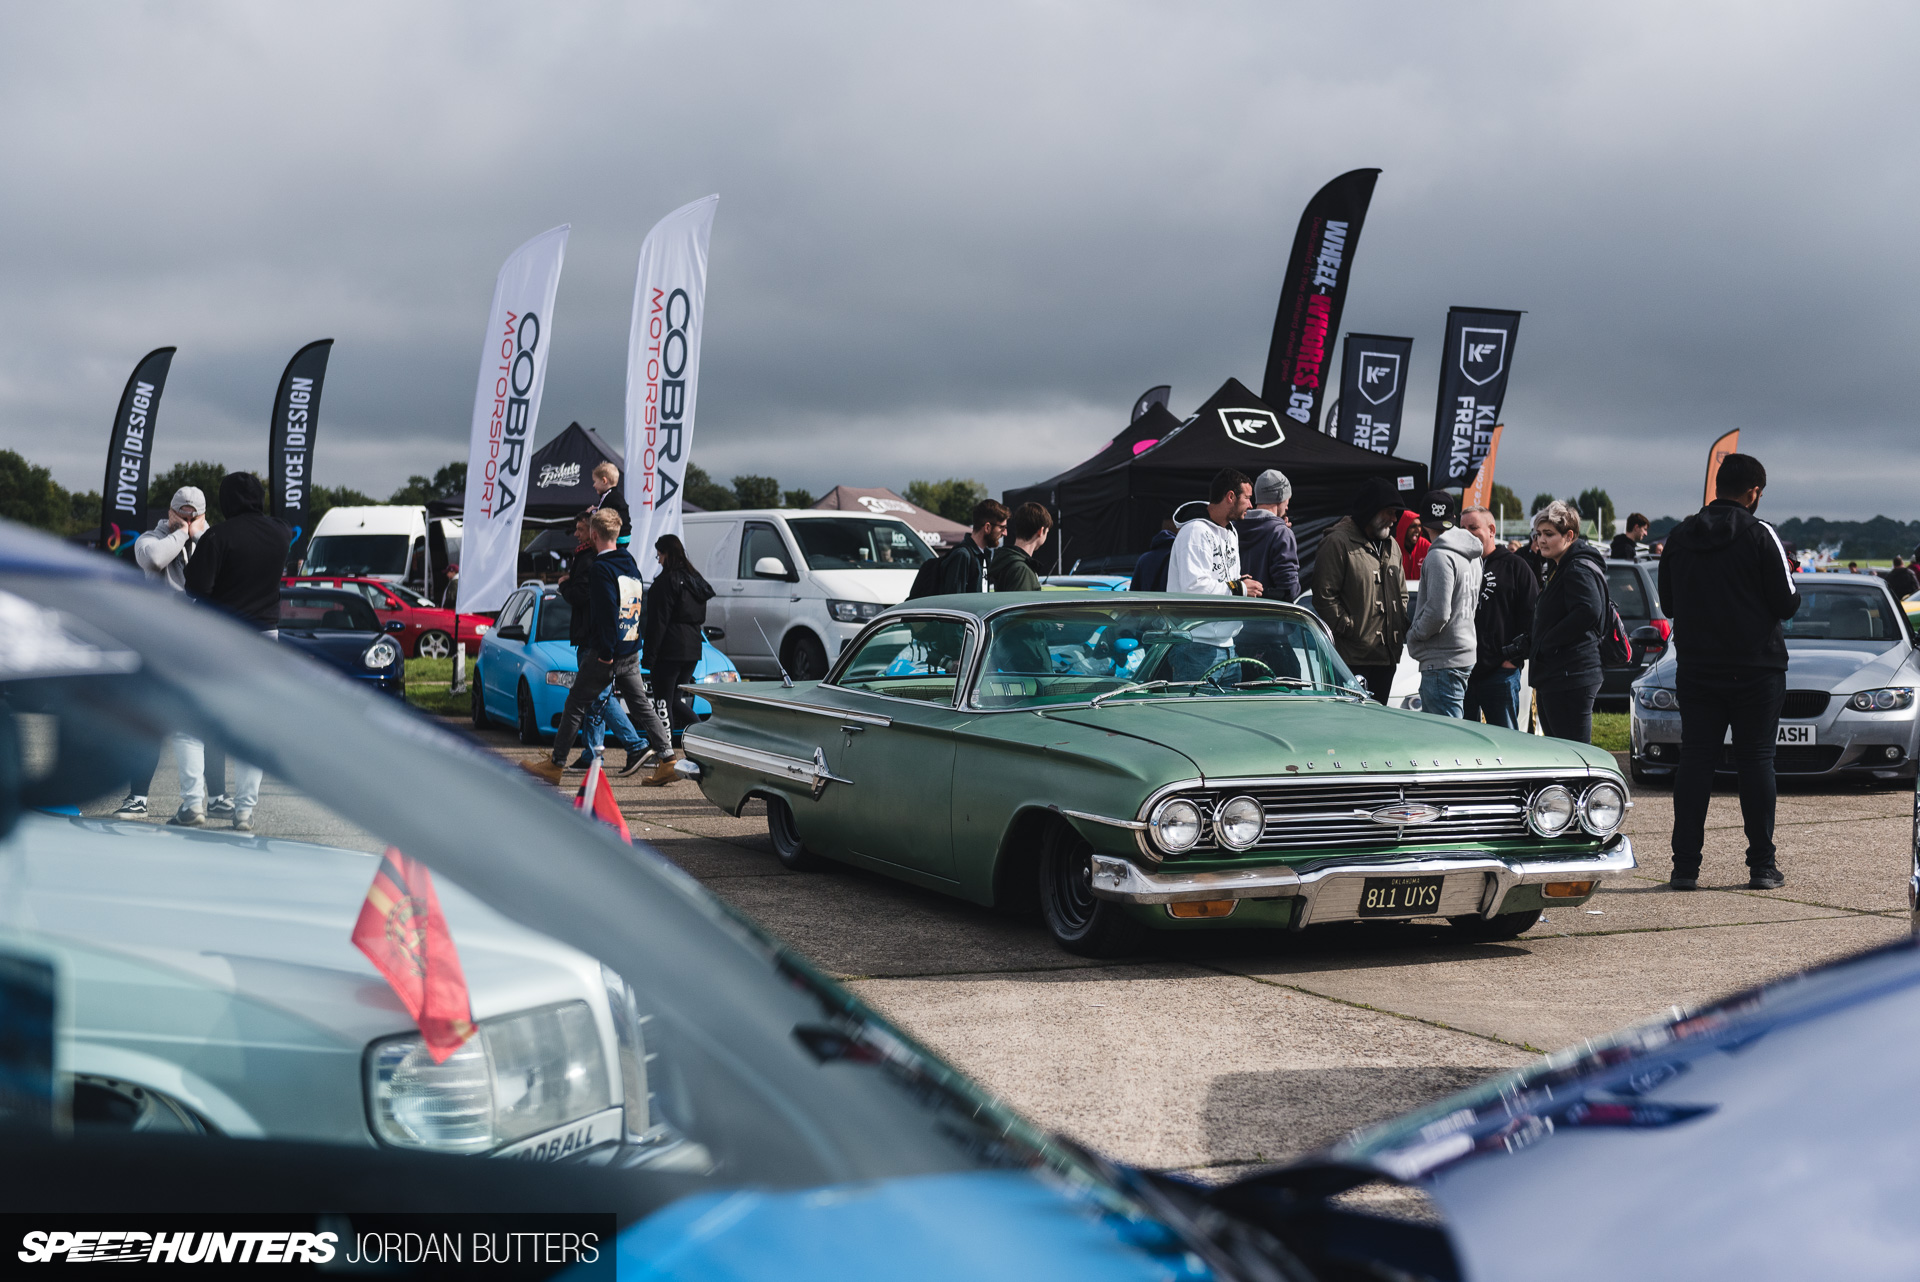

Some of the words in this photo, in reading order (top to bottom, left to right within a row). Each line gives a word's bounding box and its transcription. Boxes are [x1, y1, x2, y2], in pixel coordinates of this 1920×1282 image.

[480, 310, 518, 520] MOTORSPORT
[493, 311, 541, 519] COBRA
[642, 287, 665, 511] MOTORSPORT
[655, 287, 691, 511] COBRA
[1448, 395, 1476, 479] FREAKS
[1483, 571, 1497, 600] EAGLE
[1306, 756, 1505, 770] CHEVROLET
[1366, 888, 1397, 908] 811
[1404, 885, 1438, 907] UYS
[1391, 877, 1421, 886] OKLAHOMA
